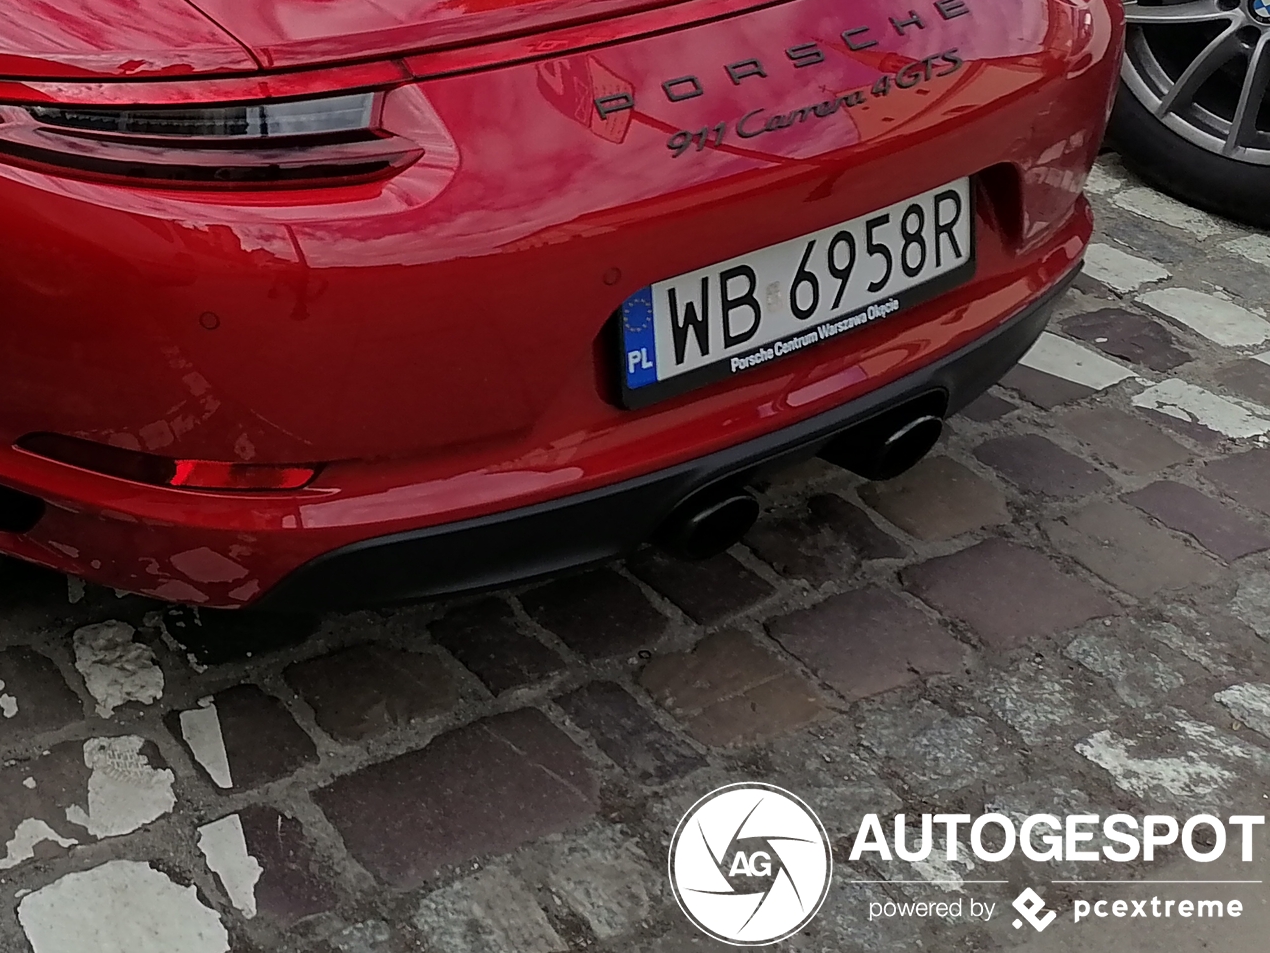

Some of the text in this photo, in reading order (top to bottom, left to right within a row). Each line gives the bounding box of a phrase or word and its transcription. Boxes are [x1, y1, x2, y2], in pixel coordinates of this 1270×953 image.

[666, 121, 727, 159] 911
[736, 89, 867, 139] Carrera
[667, 188, 963, 366] WB 6958R
[627, 348, 653, 374] PL
[731, 347, 775, 373] Porsche
[774, 330, 819, 358] Centrum
[817, 311, 868, 340] Warszawa
